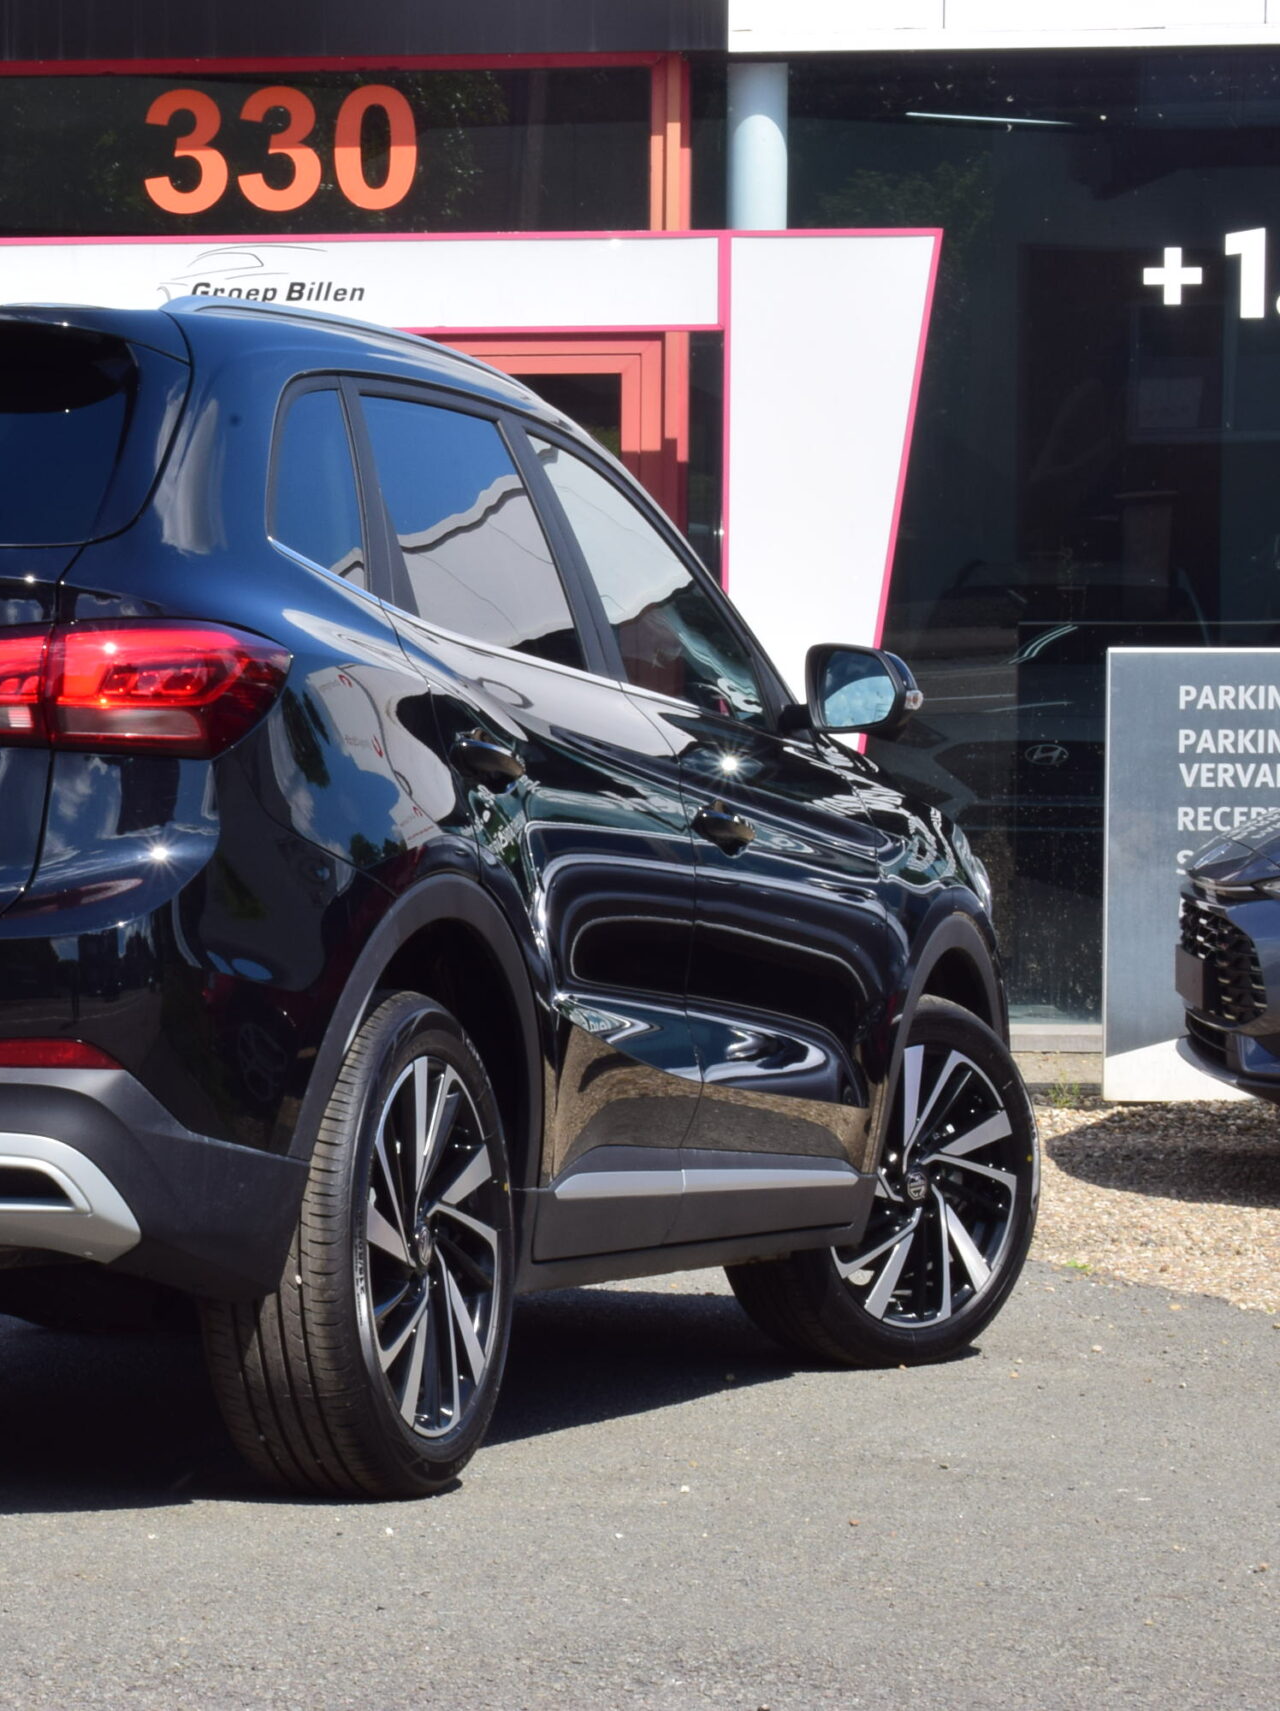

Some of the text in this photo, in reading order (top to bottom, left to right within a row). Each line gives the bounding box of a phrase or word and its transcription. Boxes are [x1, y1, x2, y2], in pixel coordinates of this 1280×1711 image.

[144, 84, 418, 215] 330
[192, 281, 365, 302] Groep Billen
[1179, 684, 1280, 710] PARKIN
[1178, 728, 1280, 754] PARKIN
[1179, 762, 1280, 788] VERVA
